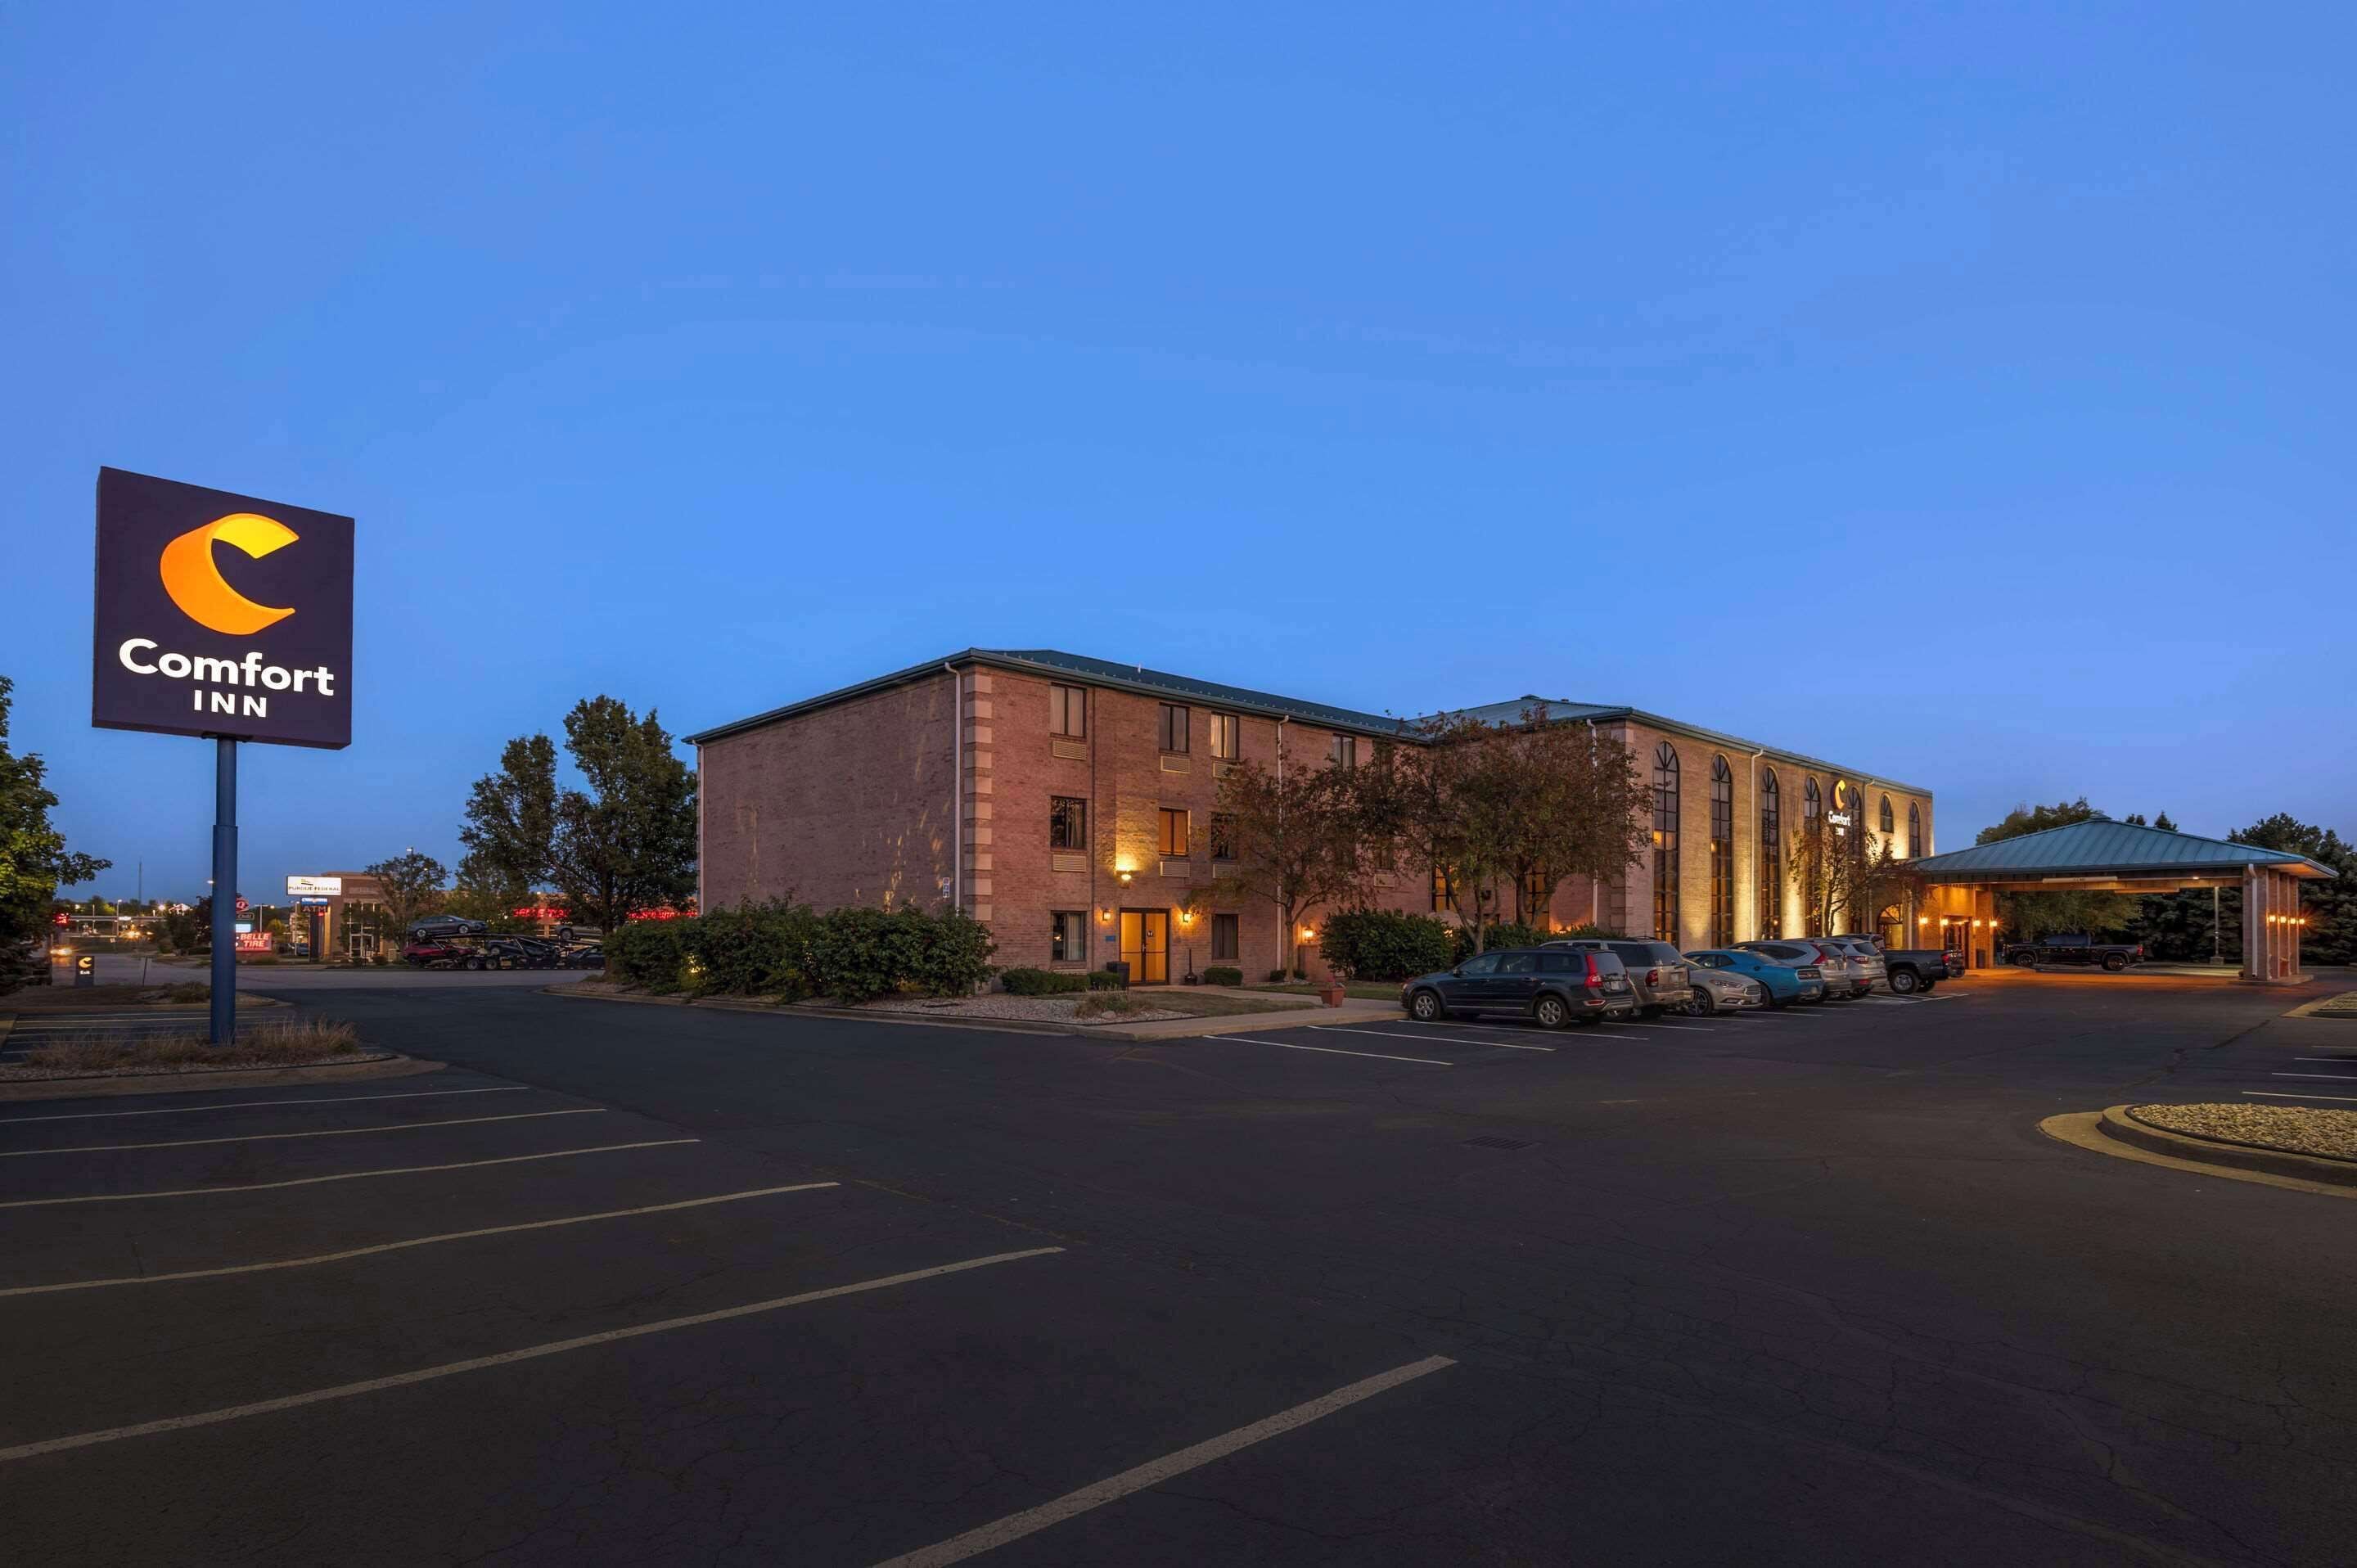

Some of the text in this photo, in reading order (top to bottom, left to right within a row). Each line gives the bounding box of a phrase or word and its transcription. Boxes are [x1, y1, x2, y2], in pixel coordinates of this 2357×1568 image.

[119, 638, 335, 696] Comfort
[194, 689, 268, 718] INN
[1827, 810, 1850, 826] Comfort
